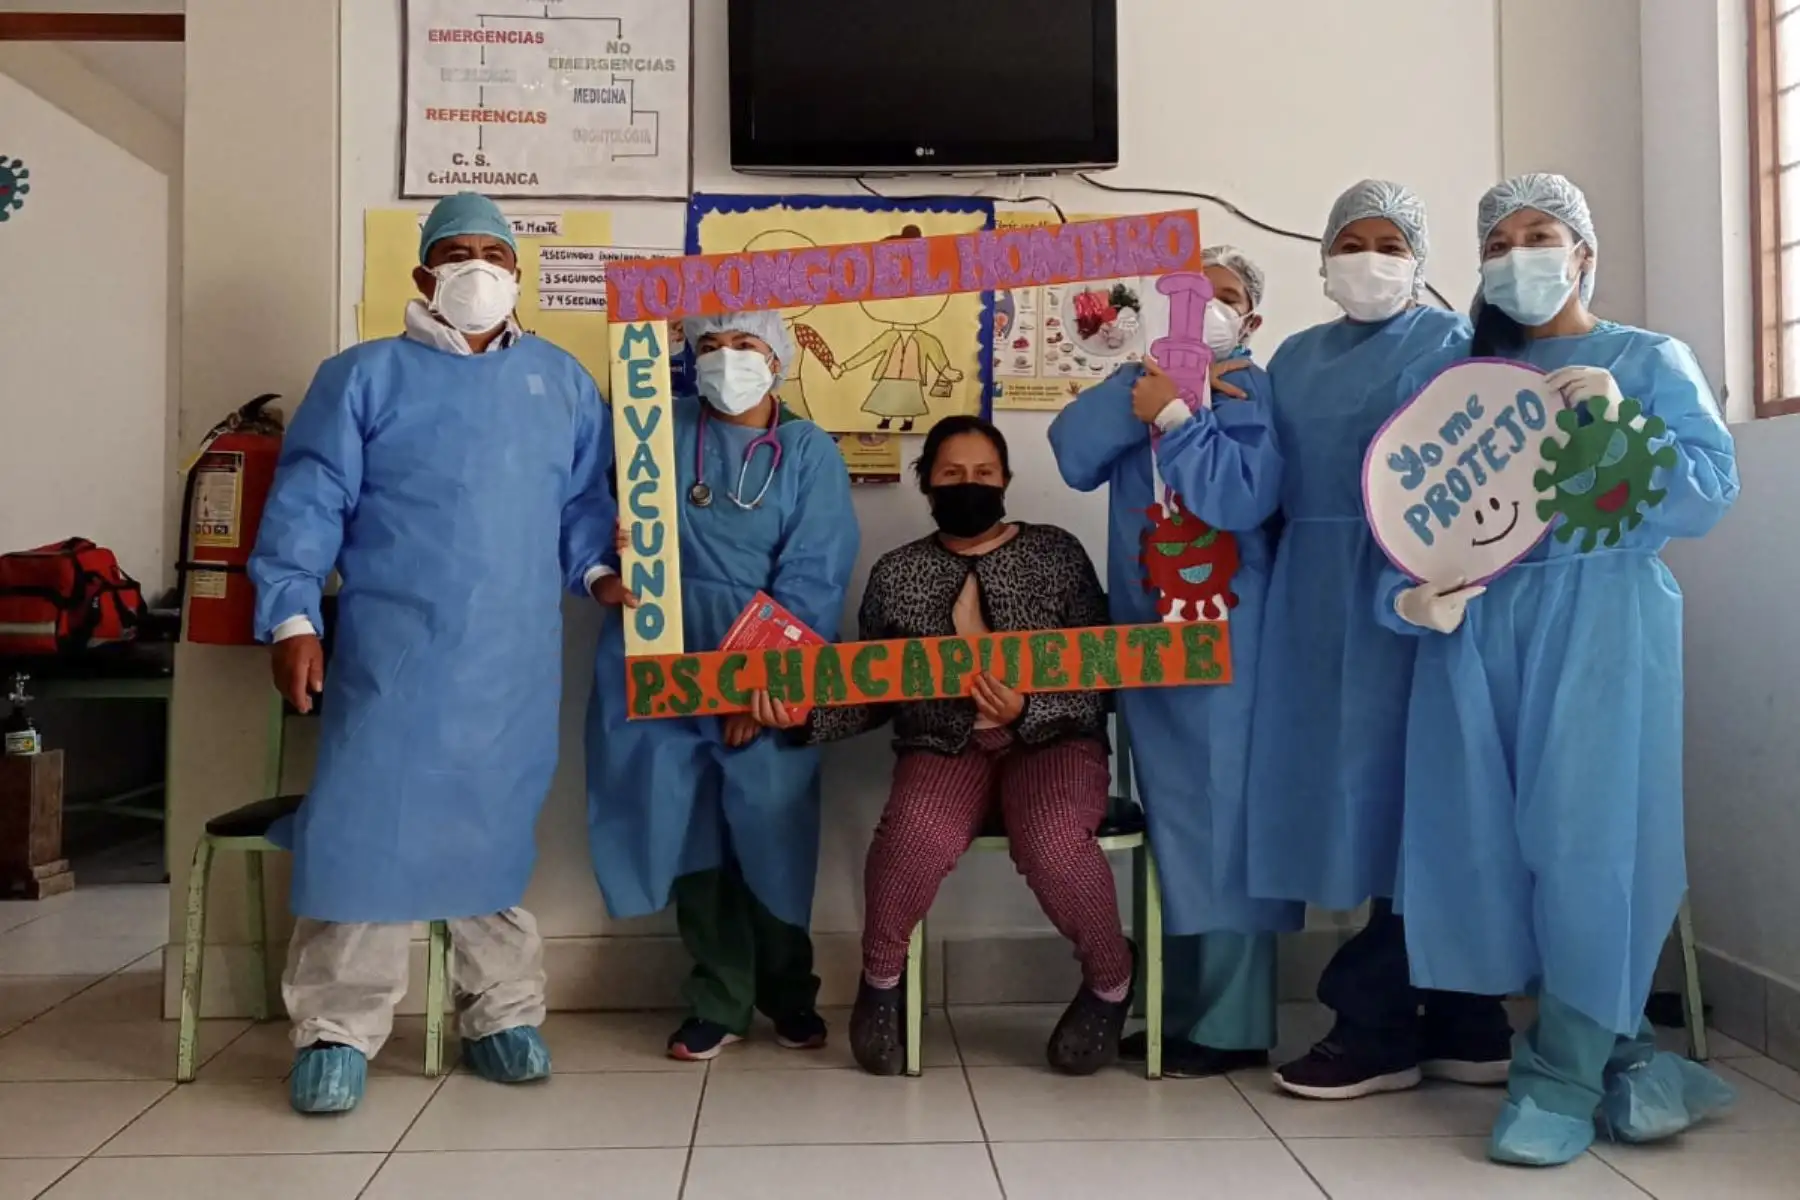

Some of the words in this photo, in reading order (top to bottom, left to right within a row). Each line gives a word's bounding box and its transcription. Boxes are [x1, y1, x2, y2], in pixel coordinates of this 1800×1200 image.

[428, 29, 545, 44] EMERGENCIAS
[606, 41, 631, 54] NO
[548, 57, 676, 72] EMERGENCIAS
[573, 87, 627, 105] MEDICINA
[426, 108, 547, 124] REFERENCIAS
[427, 171, 539, 185] CHALHUANCA
[1438, 394, 1486, 446] me
[1403, 388, 1546, 547] PROTEJO
